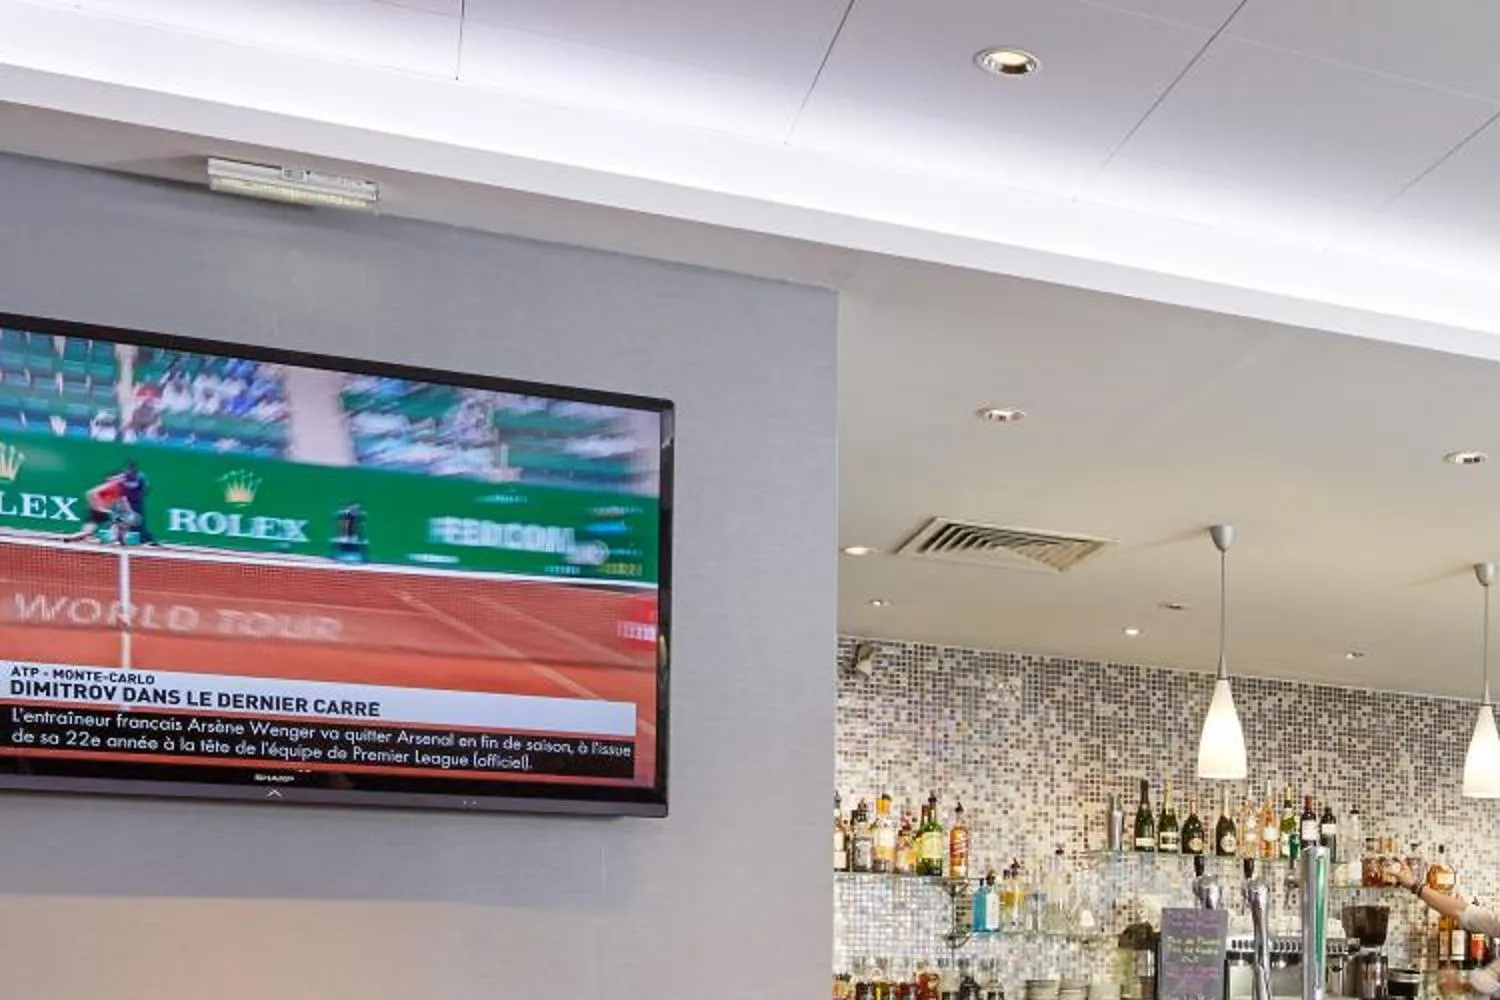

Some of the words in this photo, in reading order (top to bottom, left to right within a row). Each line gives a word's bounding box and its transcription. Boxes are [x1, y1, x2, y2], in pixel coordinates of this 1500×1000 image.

[168, 508, 311, 542] ROLEX
[15, 593, 200, 631] WORLD
[216, 608, 343, 641] TOUR
[11, 667, 39, 678] ATP
[52, 669, 156, 685] MONTE-CARLO
[10, 679, 117, 701] DIMITROV
[122, 687, 181, 705] DANS
[187, 691, 213, 707] LE
[217, 693, 308, 713] DERNIER
[313, 699, 380, 717] CARRE
[11, 707, 111, 728] L'entraîneur
[187, 717, 245, 735] Arsène
[249, 721, 316, 742] Wenger
[321, 728, 340, 740] va
[397, 730, 455, 747] Arsenal
[459, 737, 478, 749] en
[480, 735, 500, 750] fin
[503, 736, 522, 751] de
[11, 728, 35, 744] de
[40, 733, 60, 746] sa
[66, 731, 101, 747] 22e
[107, 734, 159, 751] année
[163, 736, 175, 752] à
[179, 736, 196, 753] la
[235, 740, 257, 755] de
[261, 742, 322, 761] l'équipe
[327, 745, 348, 760] de
[353, 746, 410, 763] Premier
[414, 751, 469, 768] League
